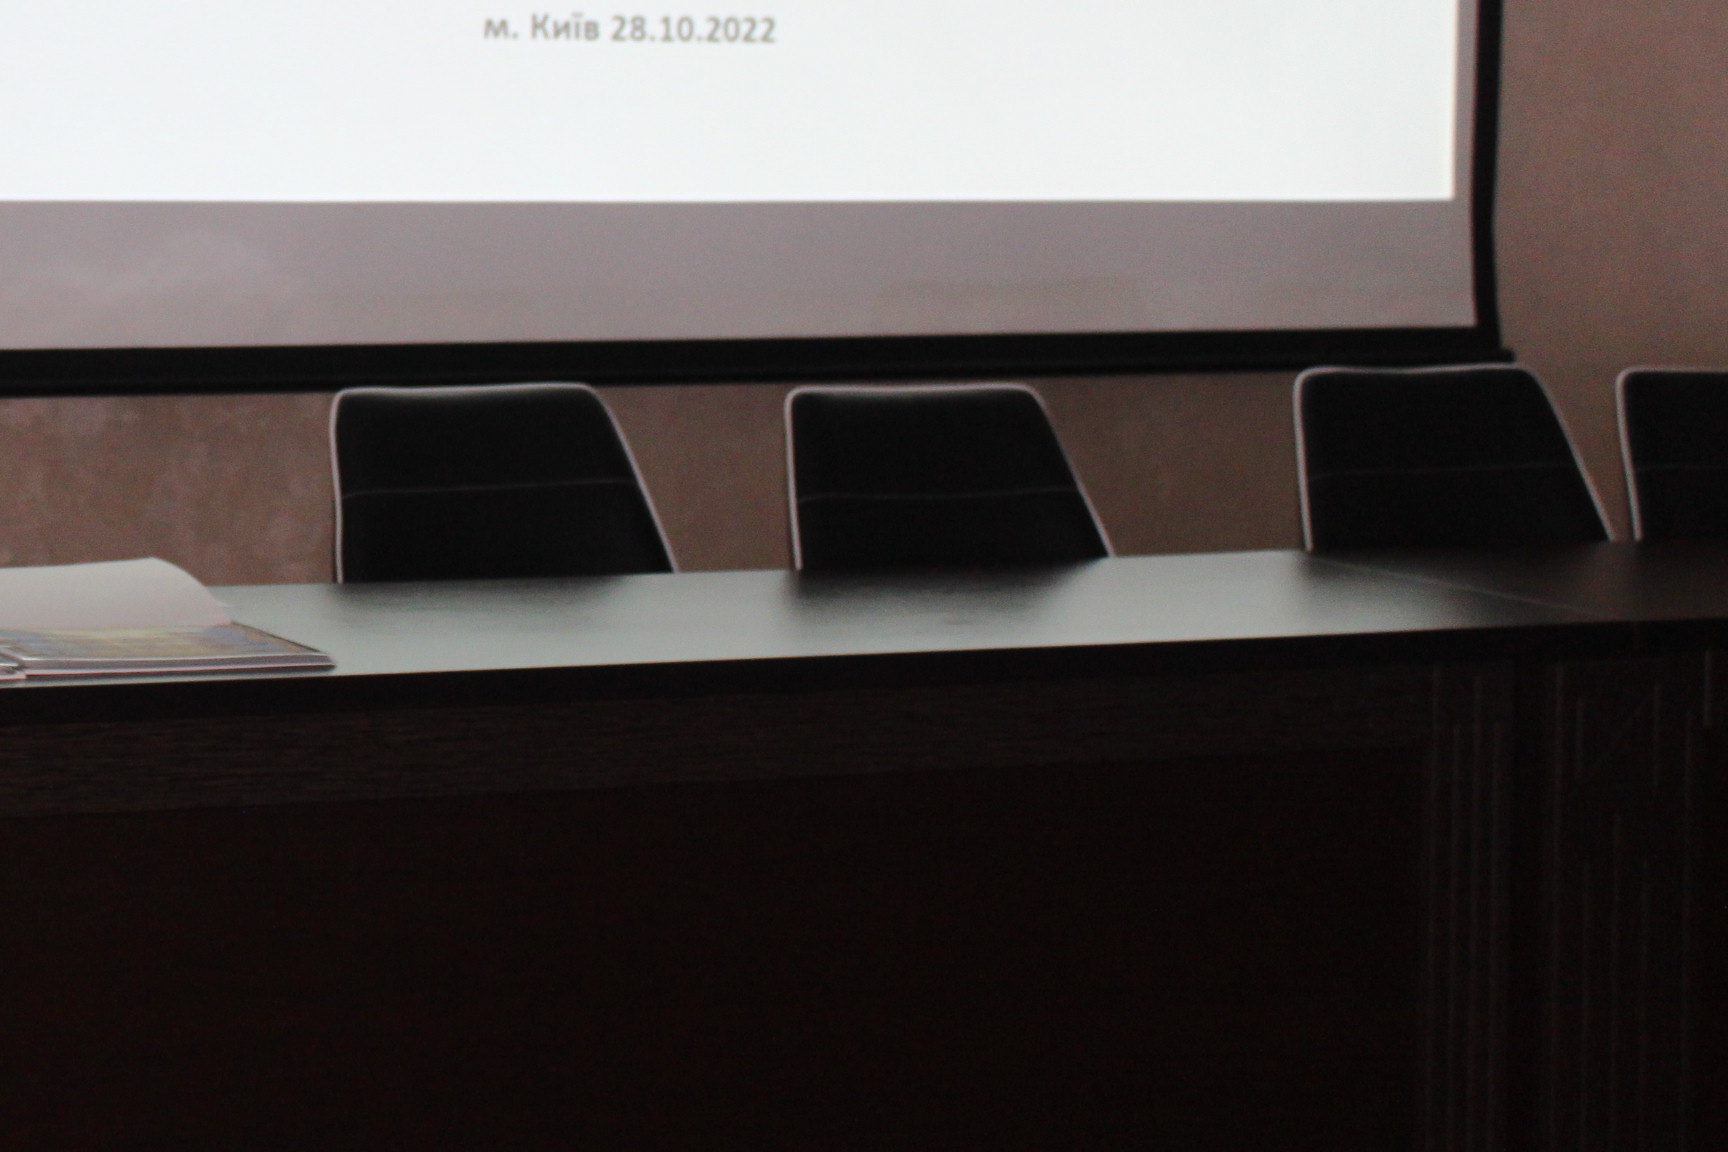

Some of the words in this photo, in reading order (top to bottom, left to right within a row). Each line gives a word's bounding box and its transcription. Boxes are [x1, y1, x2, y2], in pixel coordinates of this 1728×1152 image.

[482, 17, 519, 41] м.
[529, 11, 601, 42] Київ
[609, 14, 777, 45] 28.10.2022
